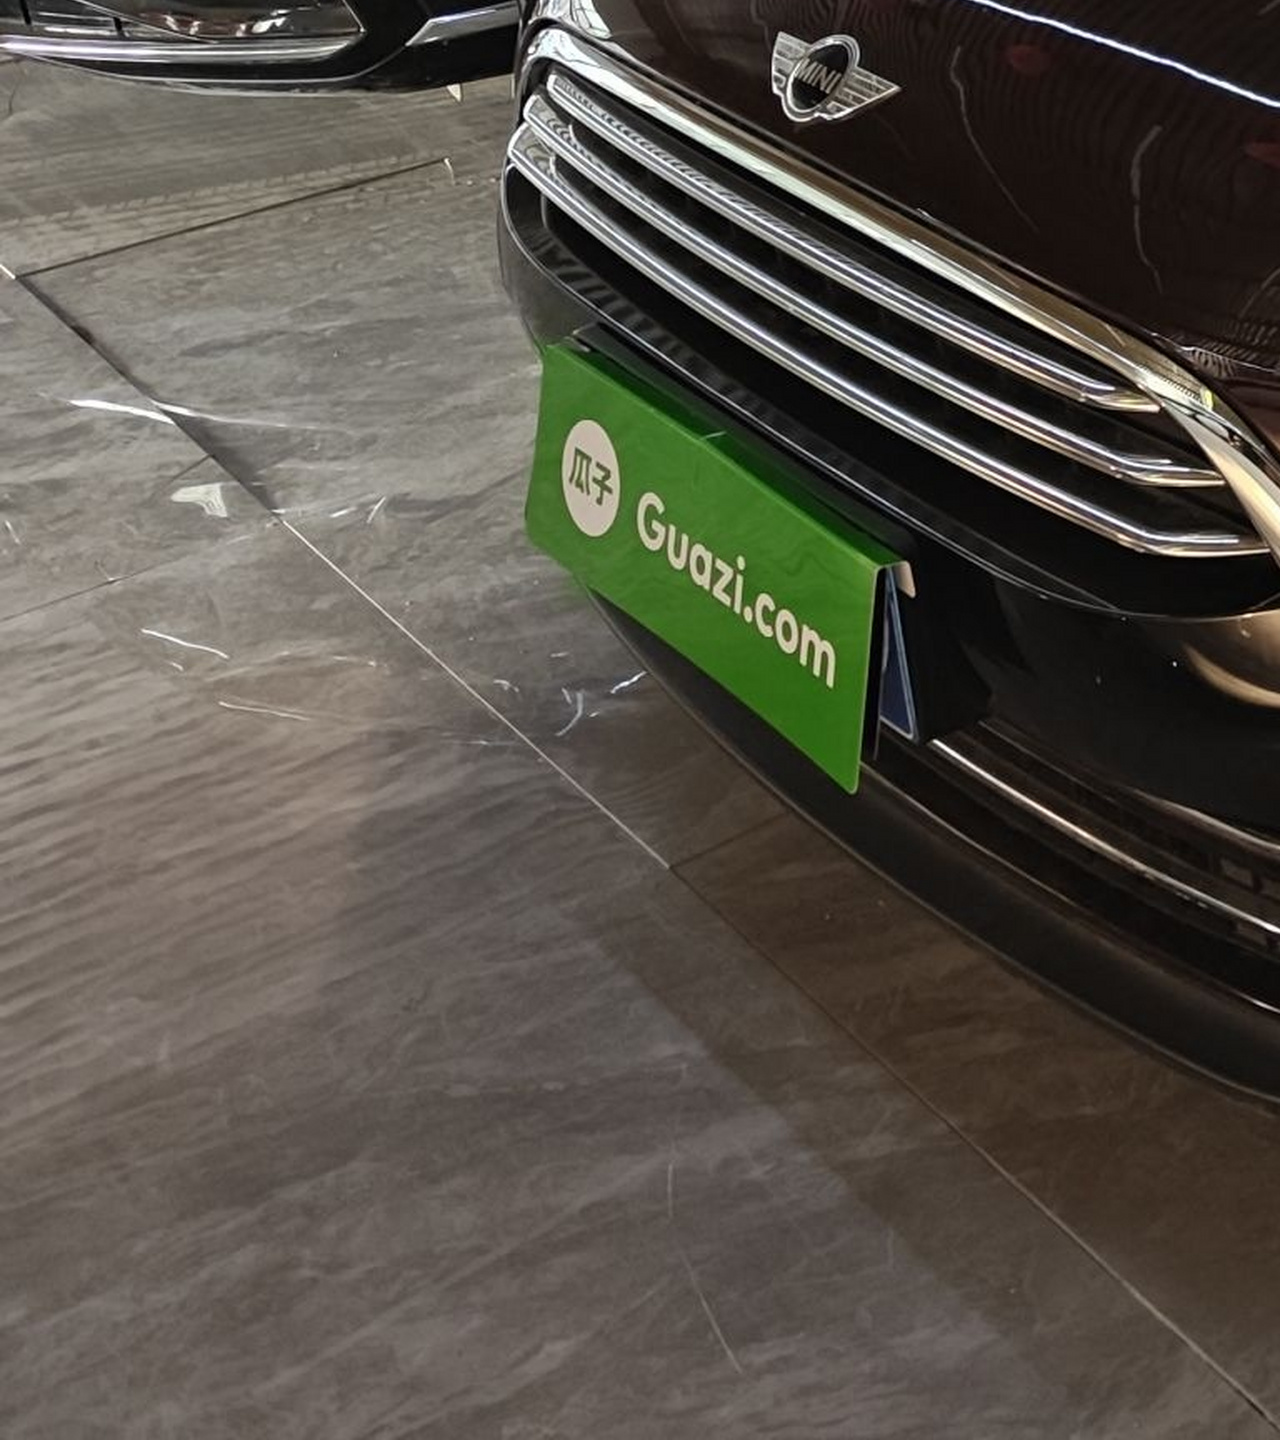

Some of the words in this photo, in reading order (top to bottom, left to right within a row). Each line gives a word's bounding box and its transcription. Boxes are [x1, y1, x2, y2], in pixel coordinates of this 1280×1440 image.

[794, 58, 842, 94] MINI
[569, 446, 614, 506] 瓜子
[636, 491, 837, 689] Guazi.com
